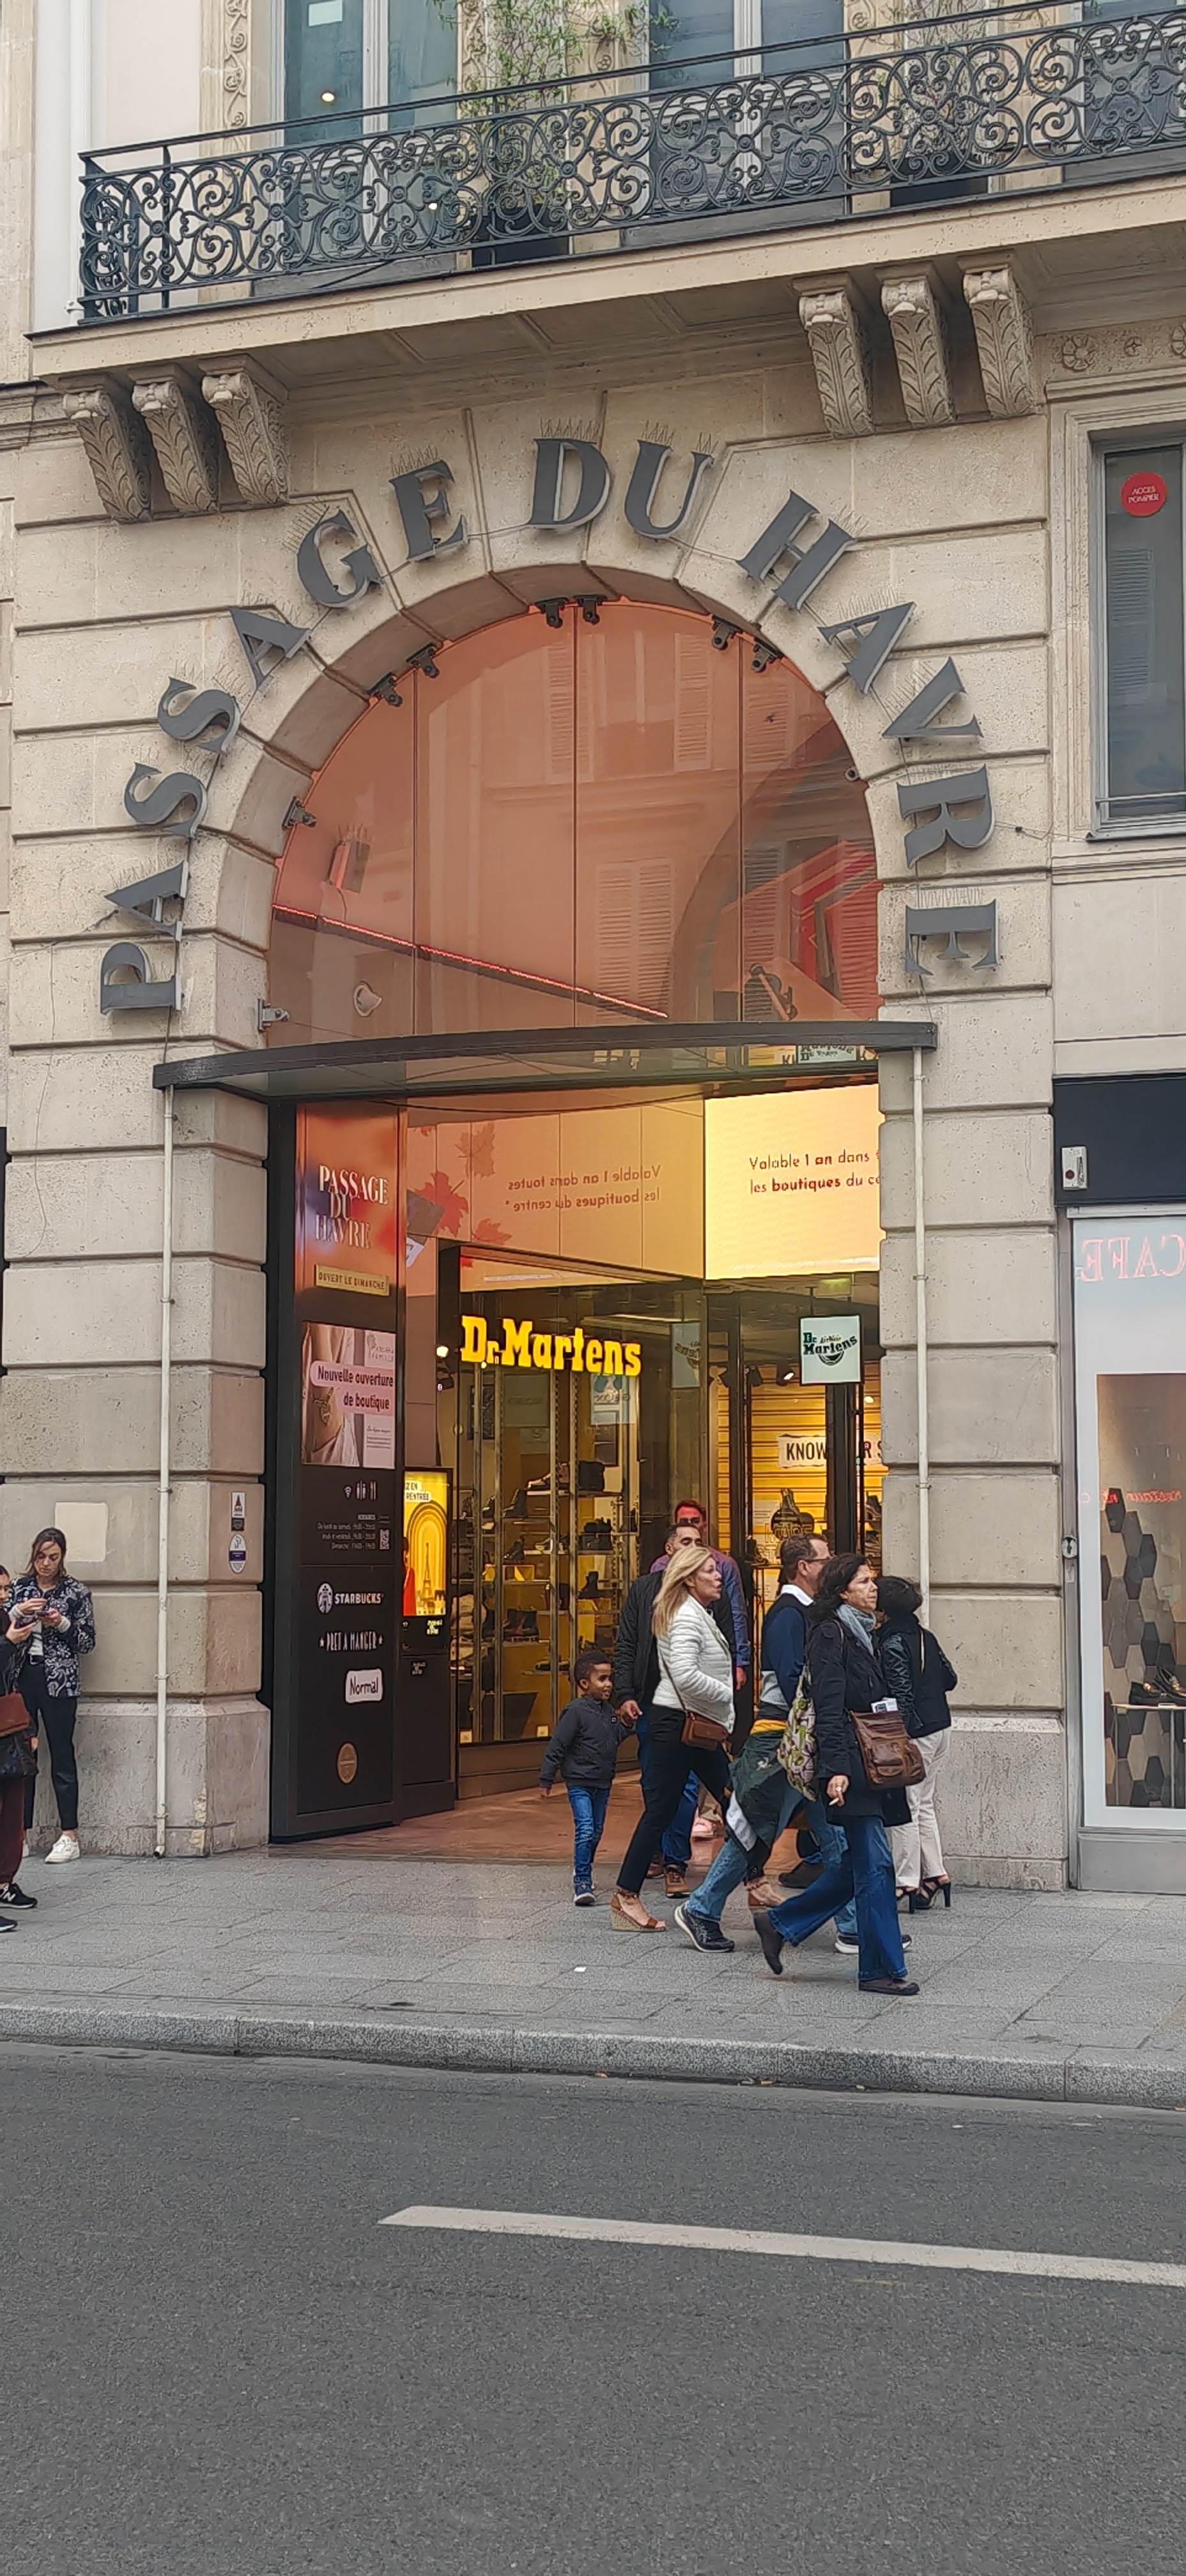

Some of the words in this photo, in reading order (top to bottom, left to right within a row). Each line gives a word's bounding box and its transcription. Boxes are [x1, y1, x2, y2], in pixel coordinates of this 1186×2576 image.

[100, 459, 468, 1015] PASSAGE
[525, 436, 714, 540] DU
[735, 489, 1003, 977] HAVRE
[750, 1153, 800, 1170] Valable
[805, 1154, 809, 1166] 1
[815, 1155, 832, 1165] an
[838, 1149, 870, 1163] dans
[319, 1163, 389, 1205] PASSAGE
[750, 1179, 767, 1194] les
[772, 1177, 841, 1192] boutiques
[846, 1172, 863, 1186] du
[330, 1192, 351, 1221] DU
[314, 1214, 371, 1249] HAVRE
[318, 1271, 343, 1284] OUVERT
[344, 1275, 353, 1285] LE
[354, 1277, 385, 1291] DIMANCHE
[803, 1335, 858, 1355] Martens
[318, 1365, 353, 1383] Nouvelle
[355, 1372, 394, 1387] ouverture
[343, 1392, 353, 1406] de
[355, 1394, 389, 1413] boutique
[334, 1593, 381, 1604] STARBUCKS
[327, 1632, 343, 1652] PRET
[350, 1630, 377, 1651] MANGER
[350, 1675, 379, 1696] Normal
